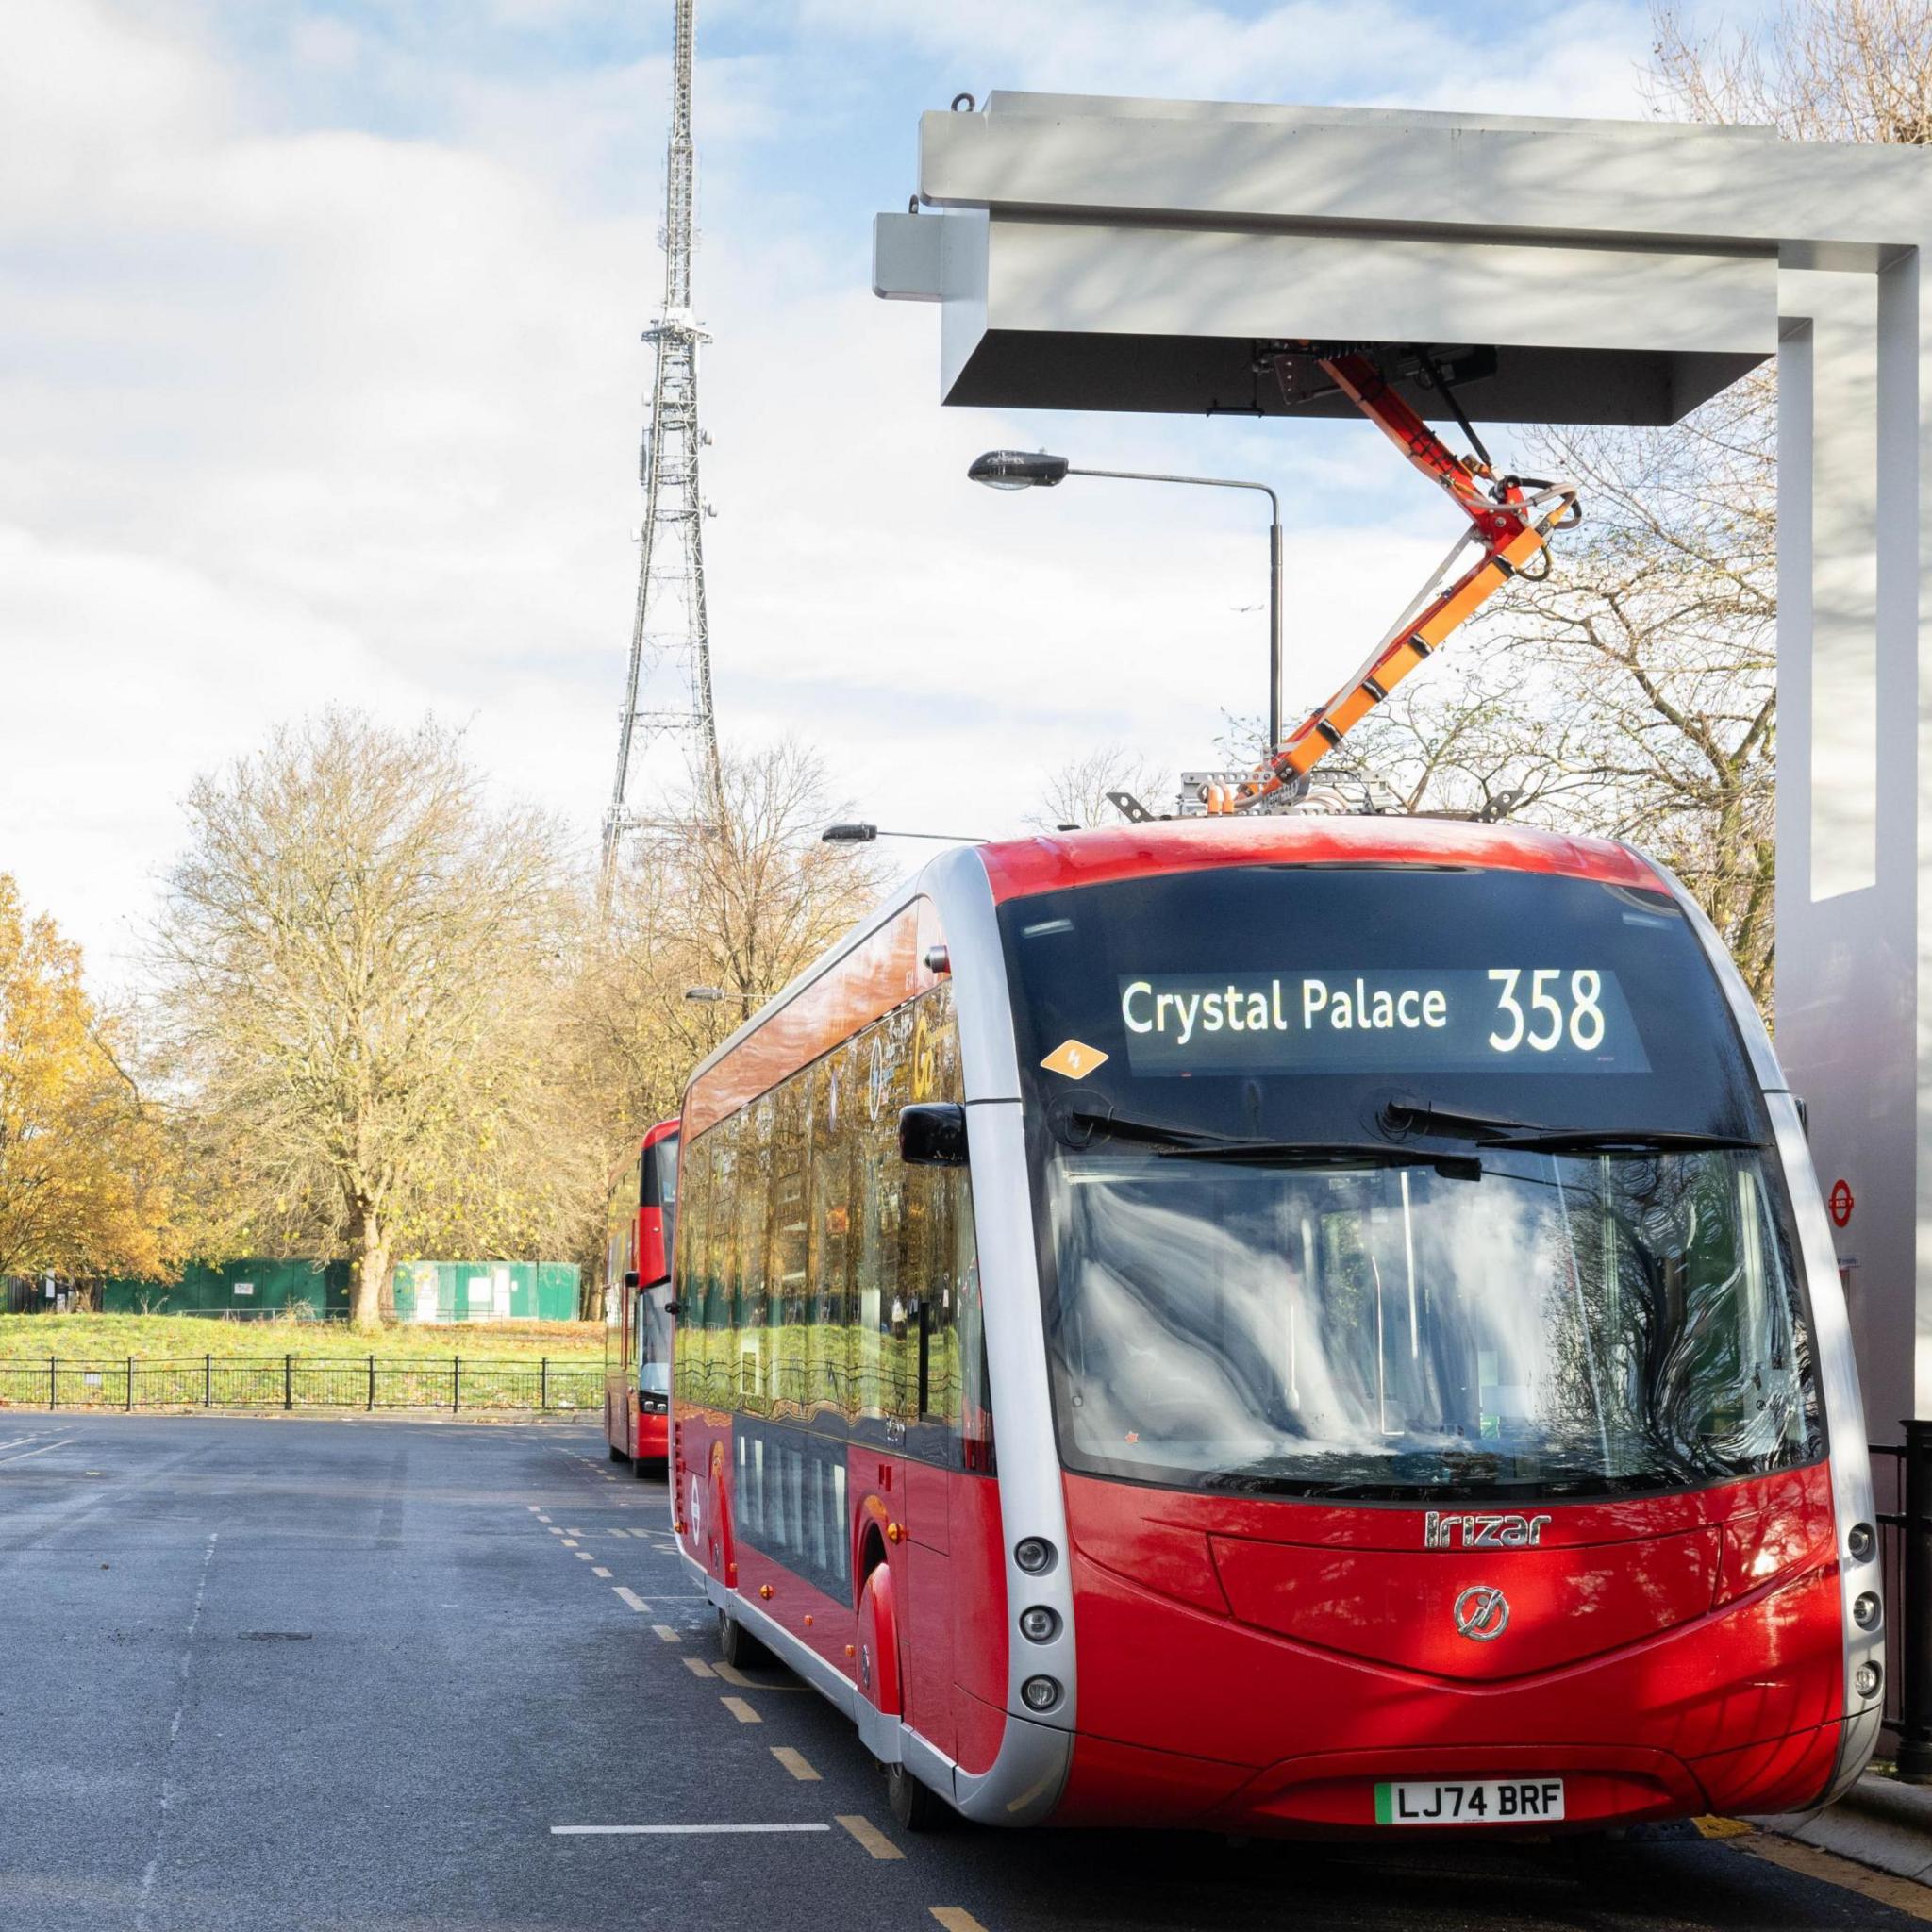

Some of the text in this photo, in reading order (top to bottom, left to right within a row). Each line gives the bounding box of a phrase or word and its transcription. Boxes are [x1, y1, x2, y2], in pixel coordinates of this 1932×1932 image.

[1122, 969, 1606, 1053] Crystal Palace 358
[1424, 1511, 1552, 1548] Irizar
[1398, 1783, 1561, 1818] LJ74 BRF
